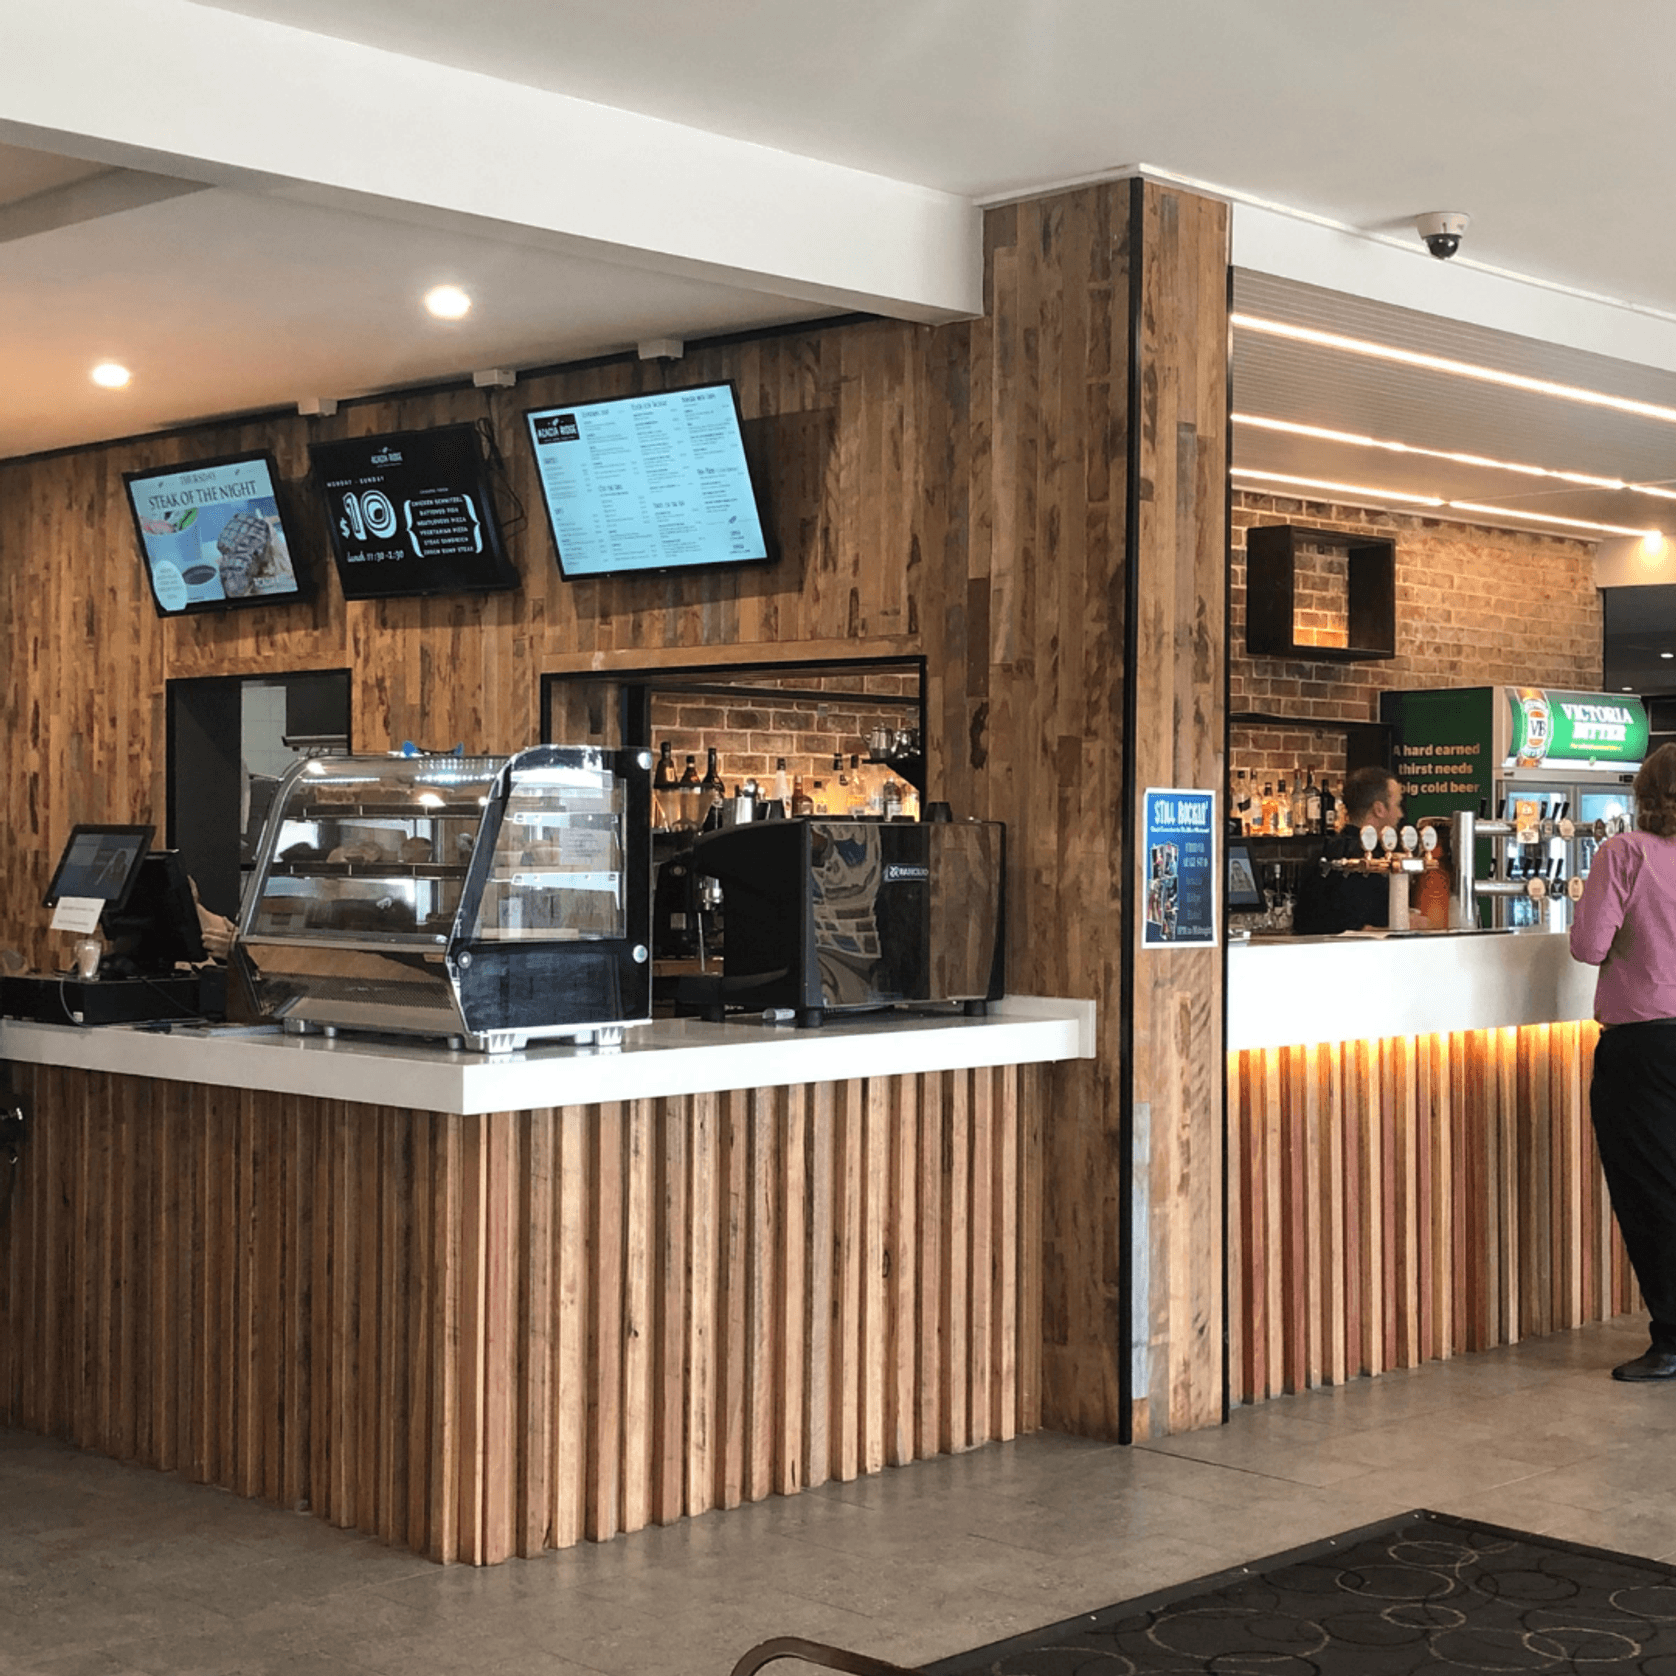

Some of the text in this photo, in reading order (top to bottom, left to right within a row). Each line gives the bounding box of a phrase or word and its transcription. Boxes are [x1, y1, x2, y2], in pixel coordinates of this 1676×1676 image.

[359, 475, 385, 484] SUNDAY
[148, 480, 256, 511] STEAK OF THE NIGHT
[1560, 703, 1635, 724] VICTORIA
[1530, 720, 1547, 737] VB
[1403, 743, 1434, 757] hard
[1435, 742, 1481, 756] earned
[1398, 761, 1474, 775] thirst needs
[1420, 781, 1448, 794] cold
[1154, 799, 1176, 825] STILL
